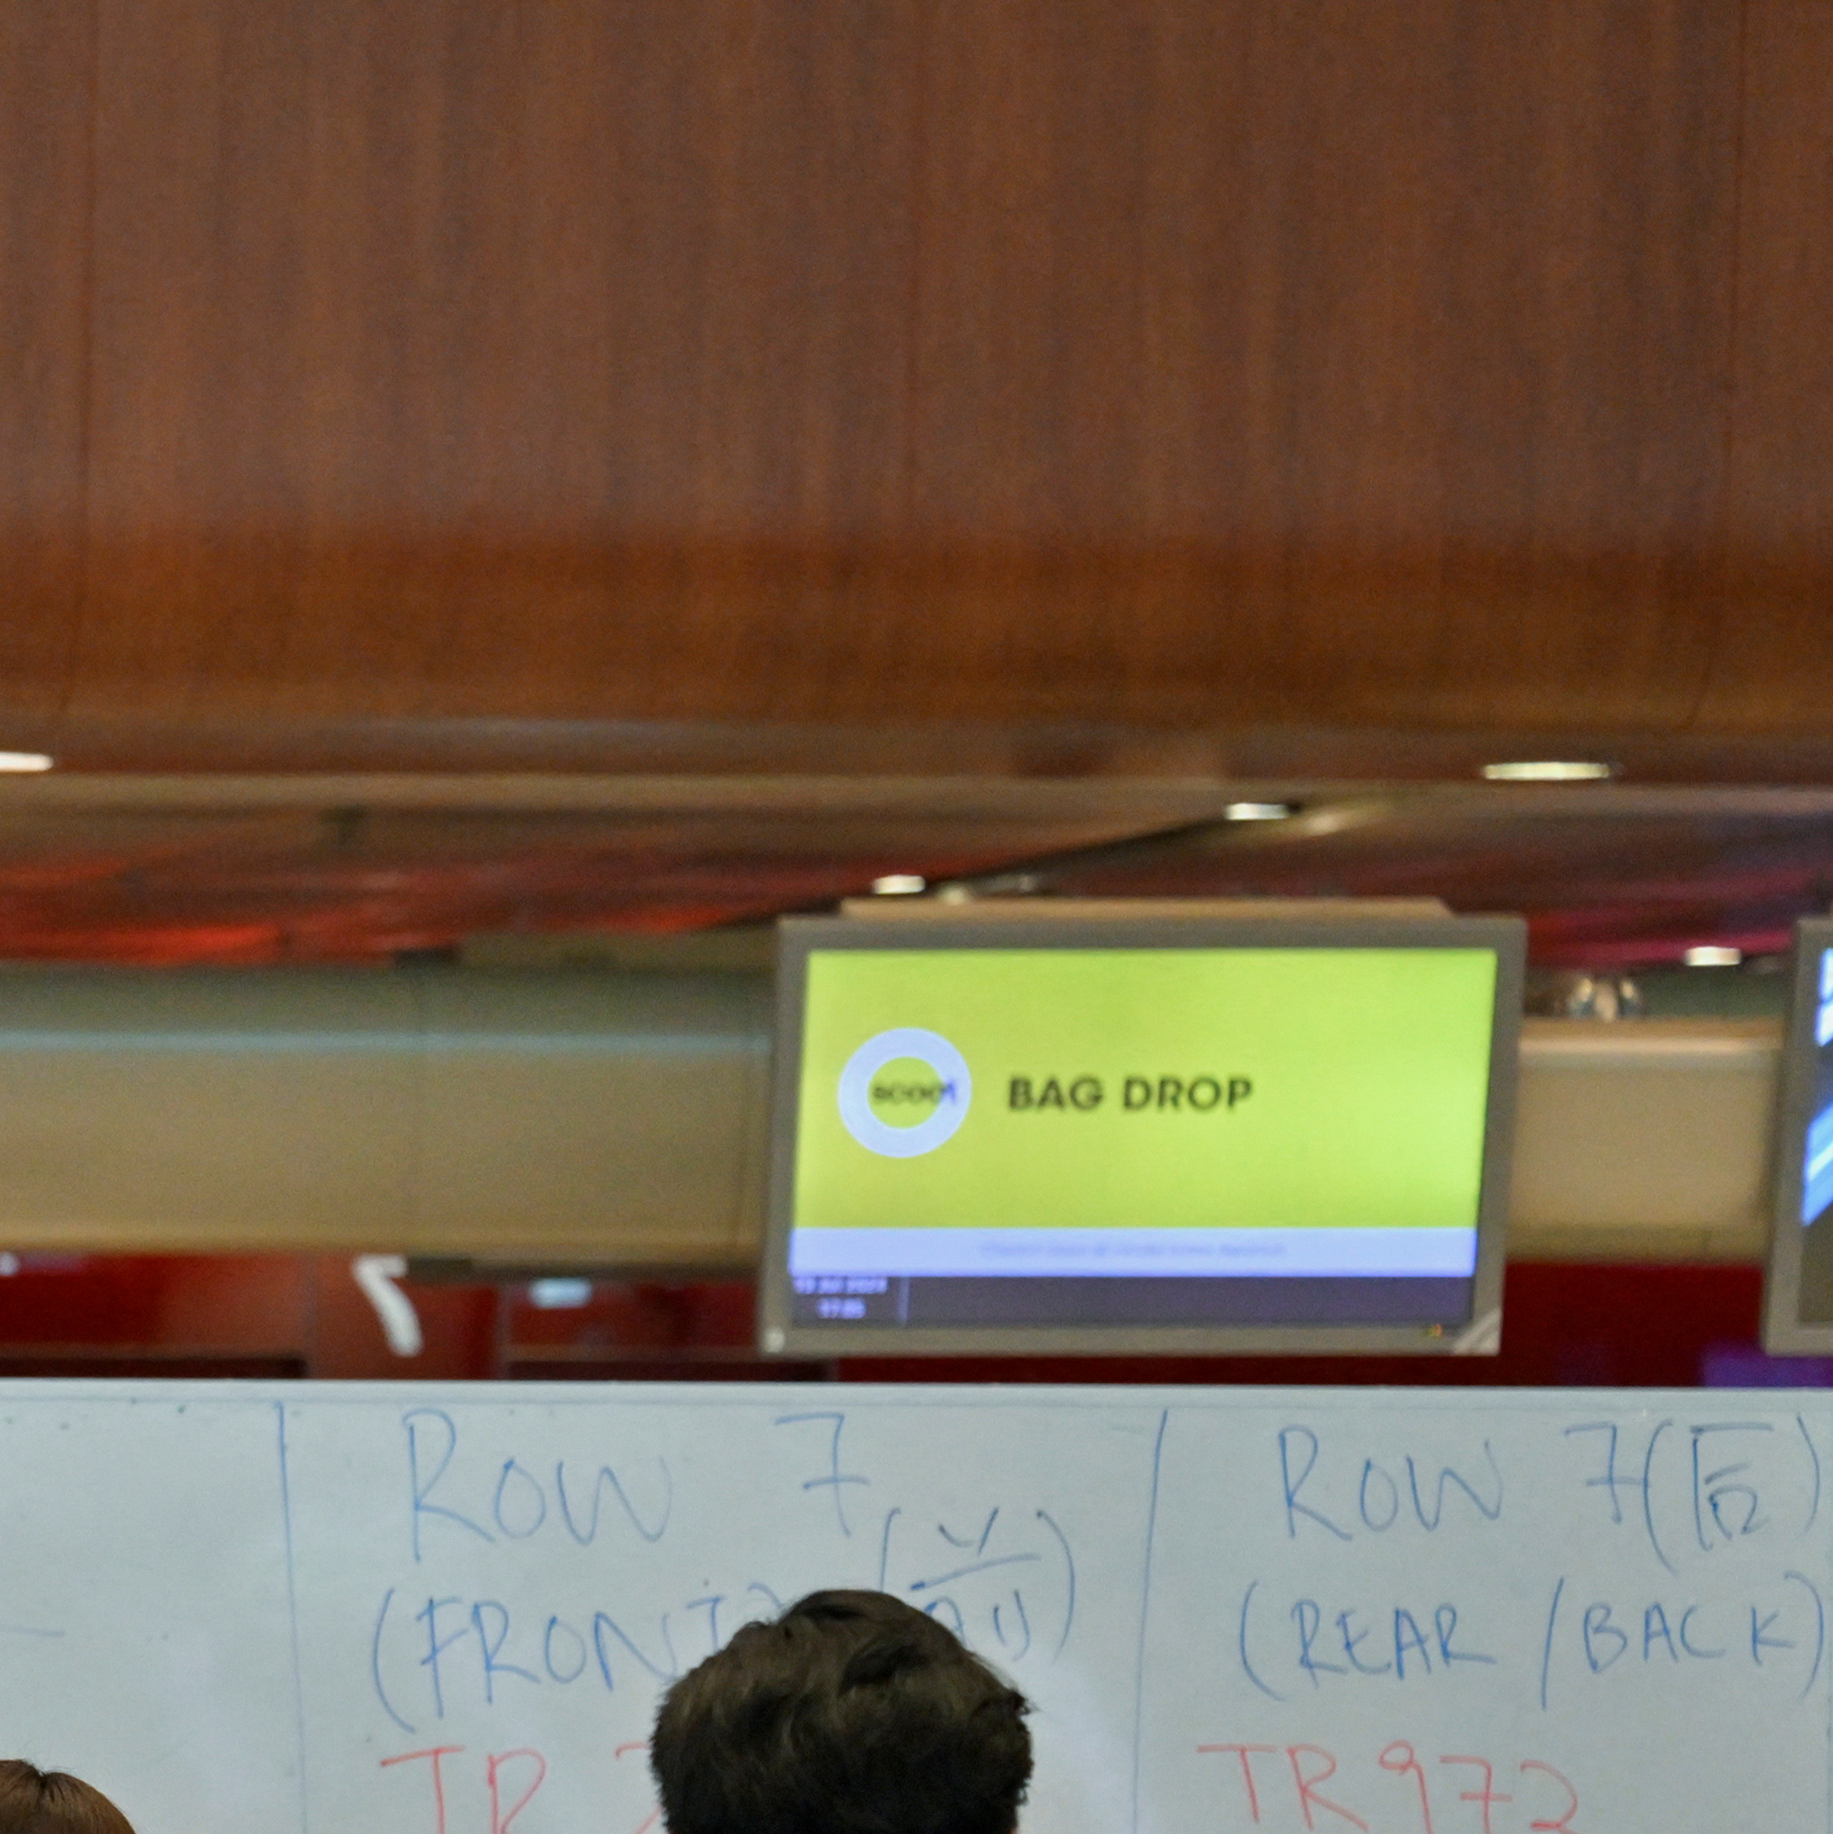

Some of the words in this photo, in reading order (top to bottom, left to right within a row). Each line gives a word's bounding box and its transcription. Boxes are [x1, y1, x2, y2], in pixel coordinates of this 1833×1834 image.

[1007, 1075, 1105, 1112] BAG
[1123, 1075, 1253, 1112] DROP
[774, 1412, 872, 1537] 7
